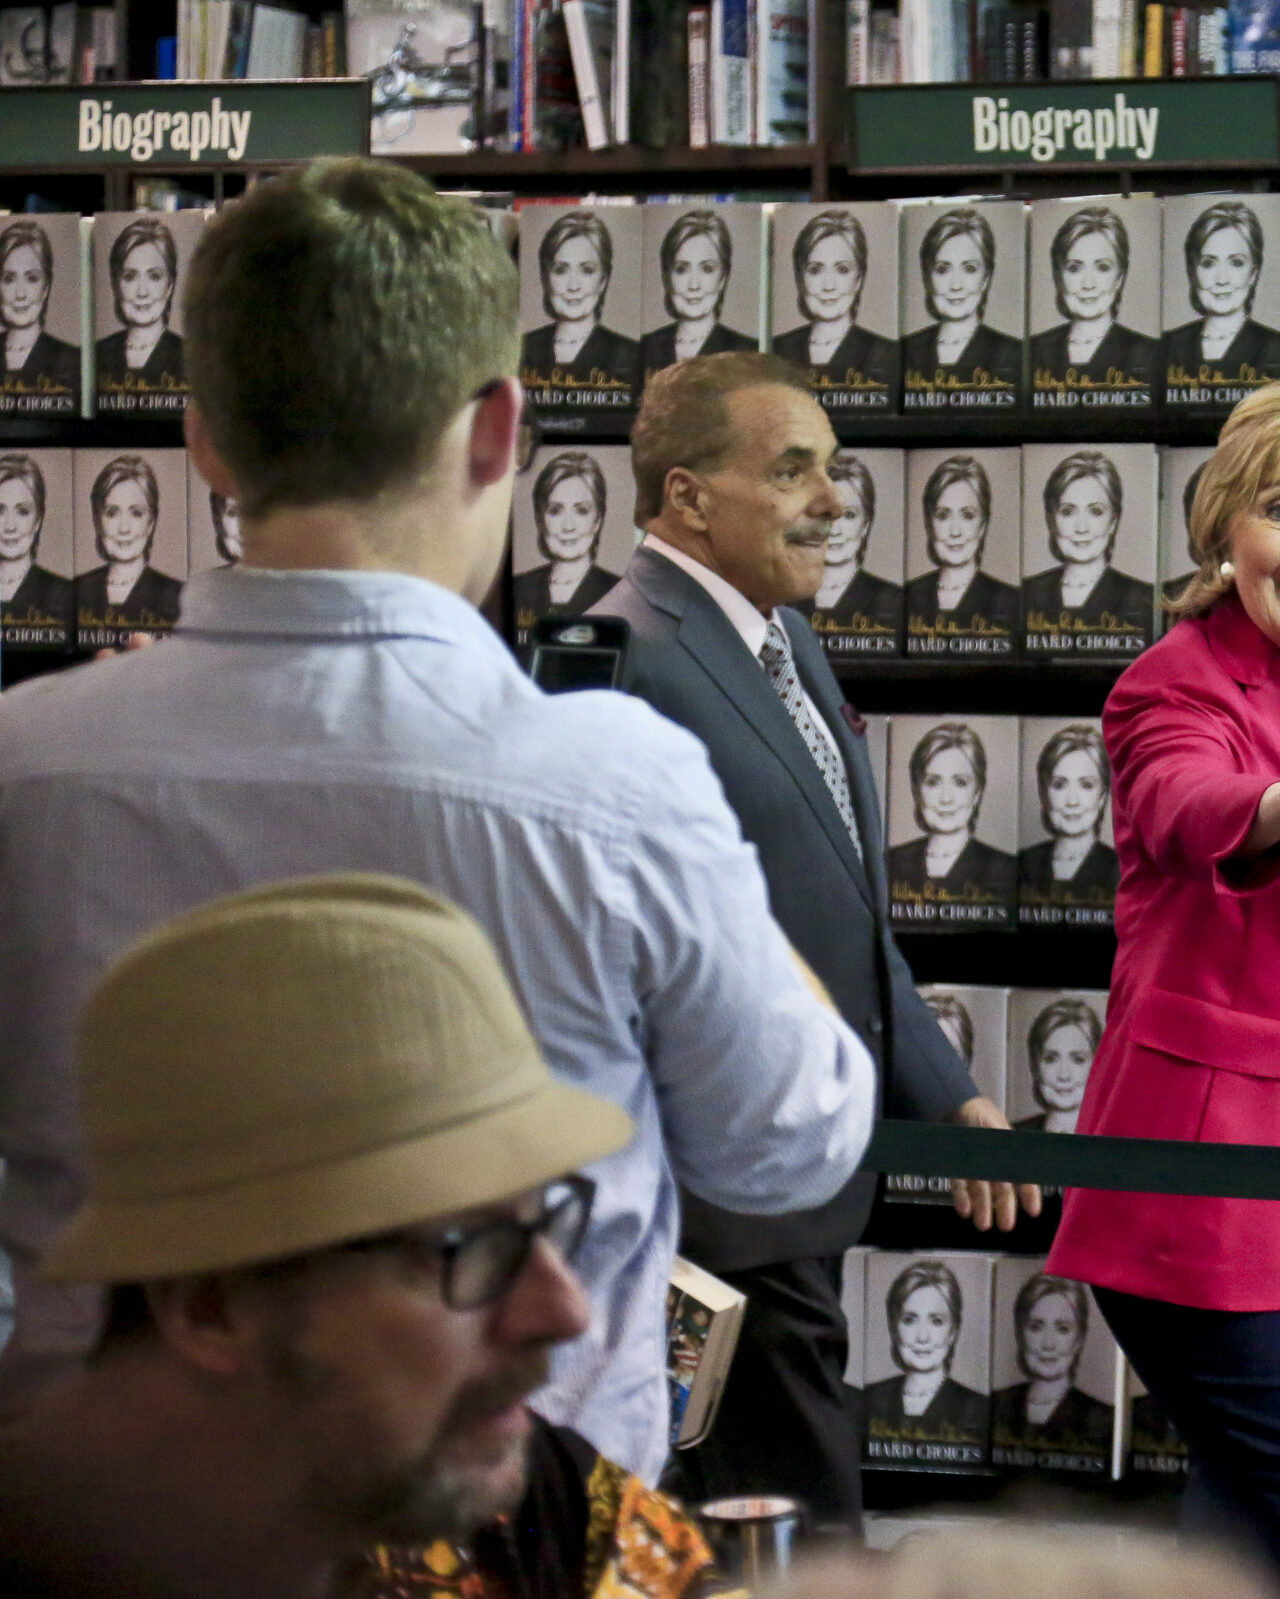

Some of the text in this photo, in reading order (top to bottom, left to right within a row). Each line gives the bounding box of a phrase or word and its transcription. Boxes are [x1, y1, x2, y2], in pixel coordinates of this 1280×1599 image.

[78, 97, 252, 162] Biography
[973, 93, 1160, 161] Biography
[0, 396, 74, 411] RD CHOICES
[99, 396, 188, 410] HARD CHOIC
[566, 391, 631, 405] CHOICES
[822, 391, 888, 407] CHOICES
[904, 391, 1015, 407] HARD CHOICES
[1033, 390, 1151, 407] HARD CHOICES
[1167, 388, 1212, 403] HARD
[6, 627, 66, 644] CHOICES
[78, 629, 115, 645] HARD
[828, 634, 896, 650] CHOICES
[1027, 634, 1146, 650] HARD CHOICES
[907, 636, 1011, 652] HARD CHOICES
[892, 903, 1008, 920] HARD CHOICES
[1019, 906, 1113, 923] HARD CHOIC
[869, 1441, 981, 1462] HARD CHOICES
